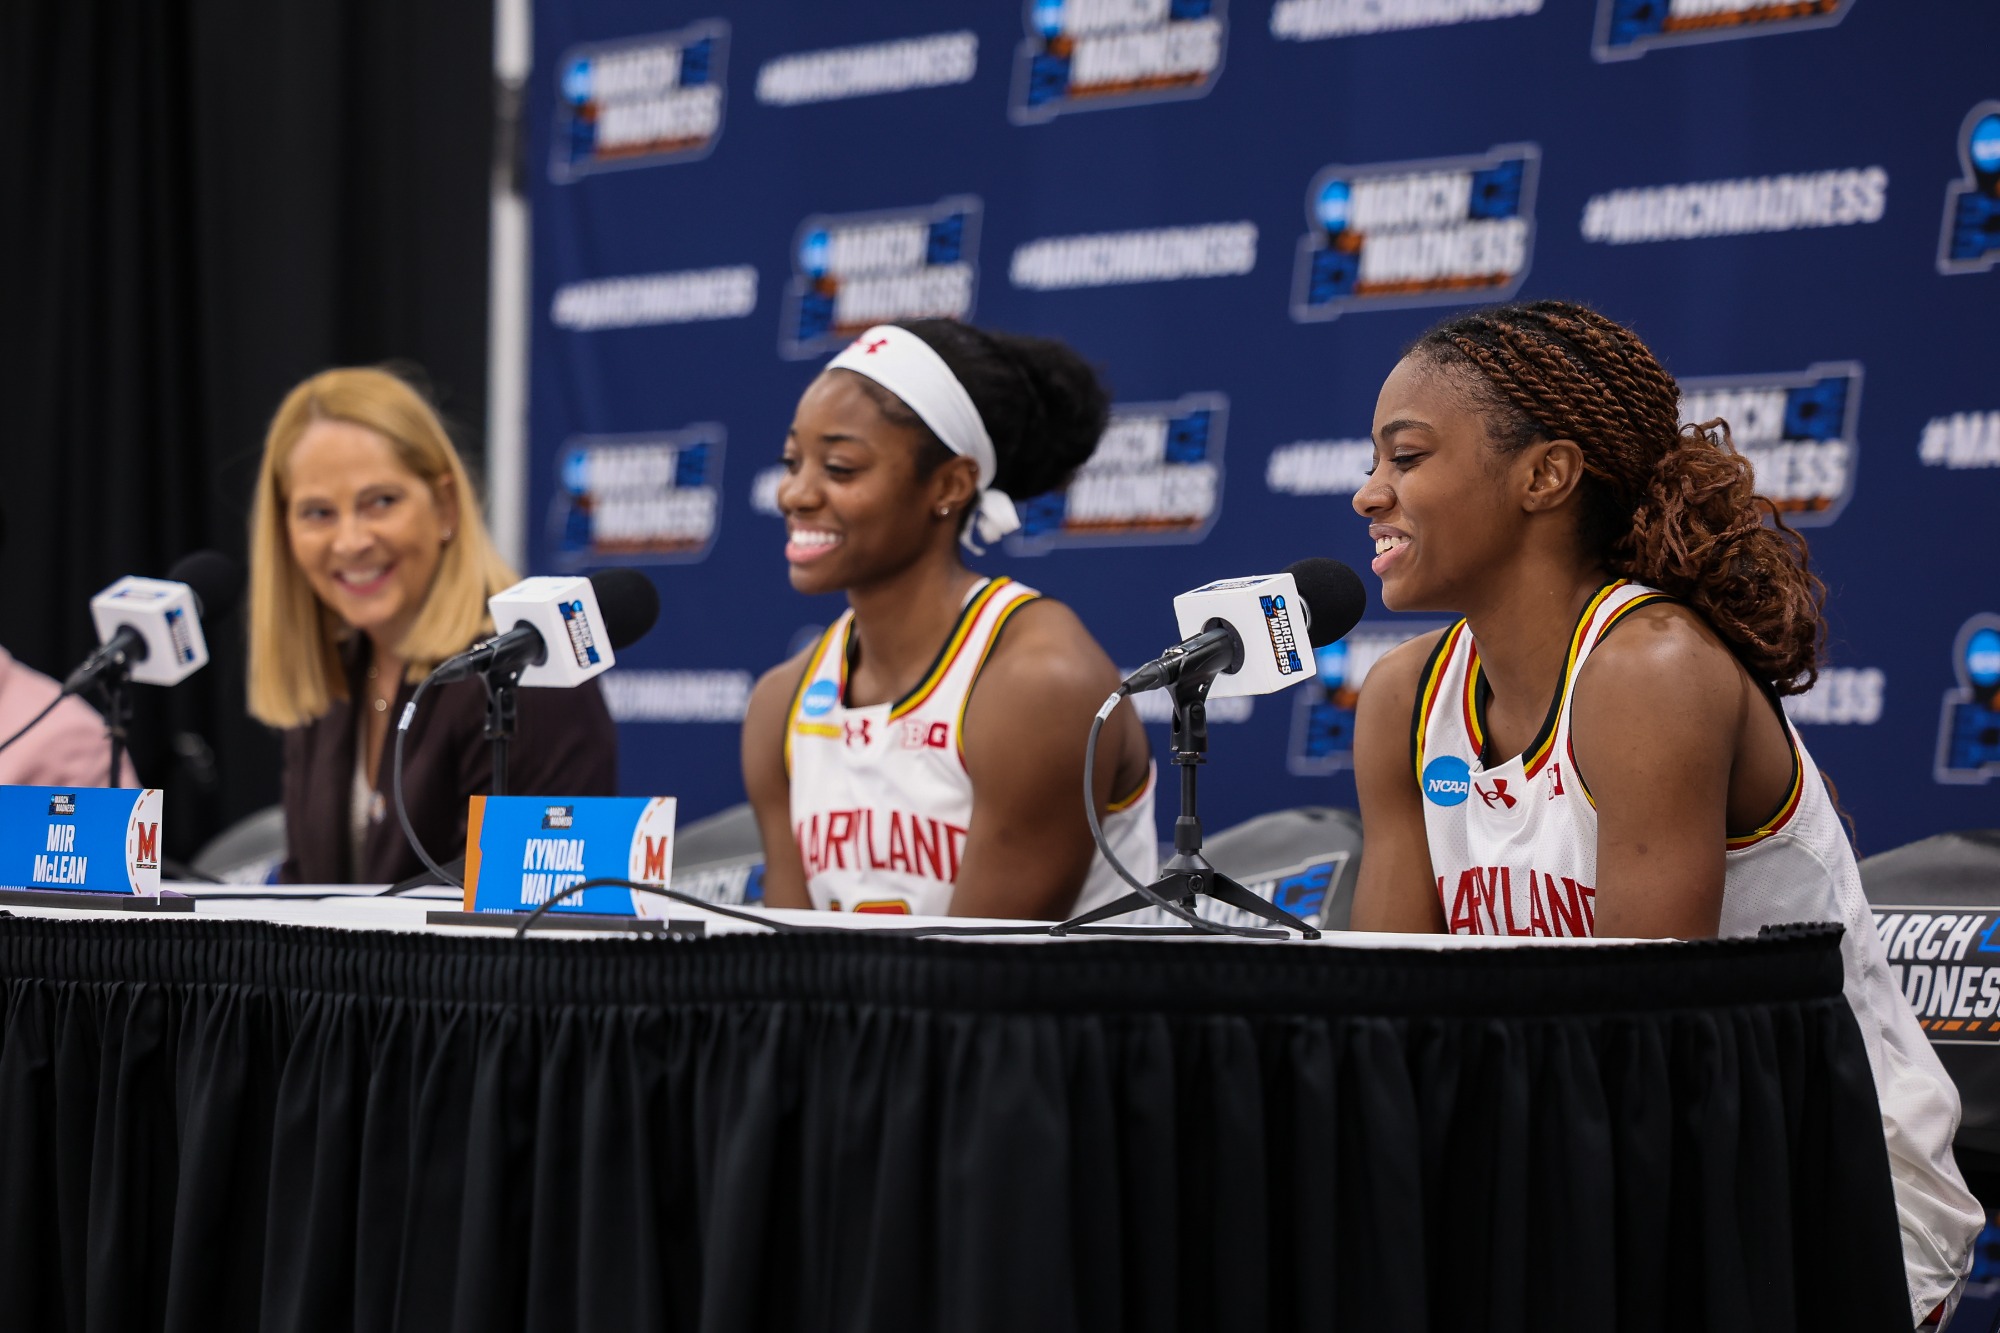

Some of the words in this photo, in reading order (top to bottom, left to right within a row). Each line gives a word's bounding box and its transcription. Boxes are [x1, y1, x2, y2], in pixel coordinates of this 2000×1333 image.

[1580, 165, 1888, 244] #MARCHMADNESS
[1270, 617, 1292, 674] MADNESS
[1277, 608, 1294, 651] MARCH
[1428, 779, 1468, 794] NCAA
[46, 823, 76, 852] MIR
[136, 821, 159, 863] M
[522, 838, 585, 872] KYNDAL
[642, 836, 668, 880] M
[32, 854, 88, 884] McLEAN
